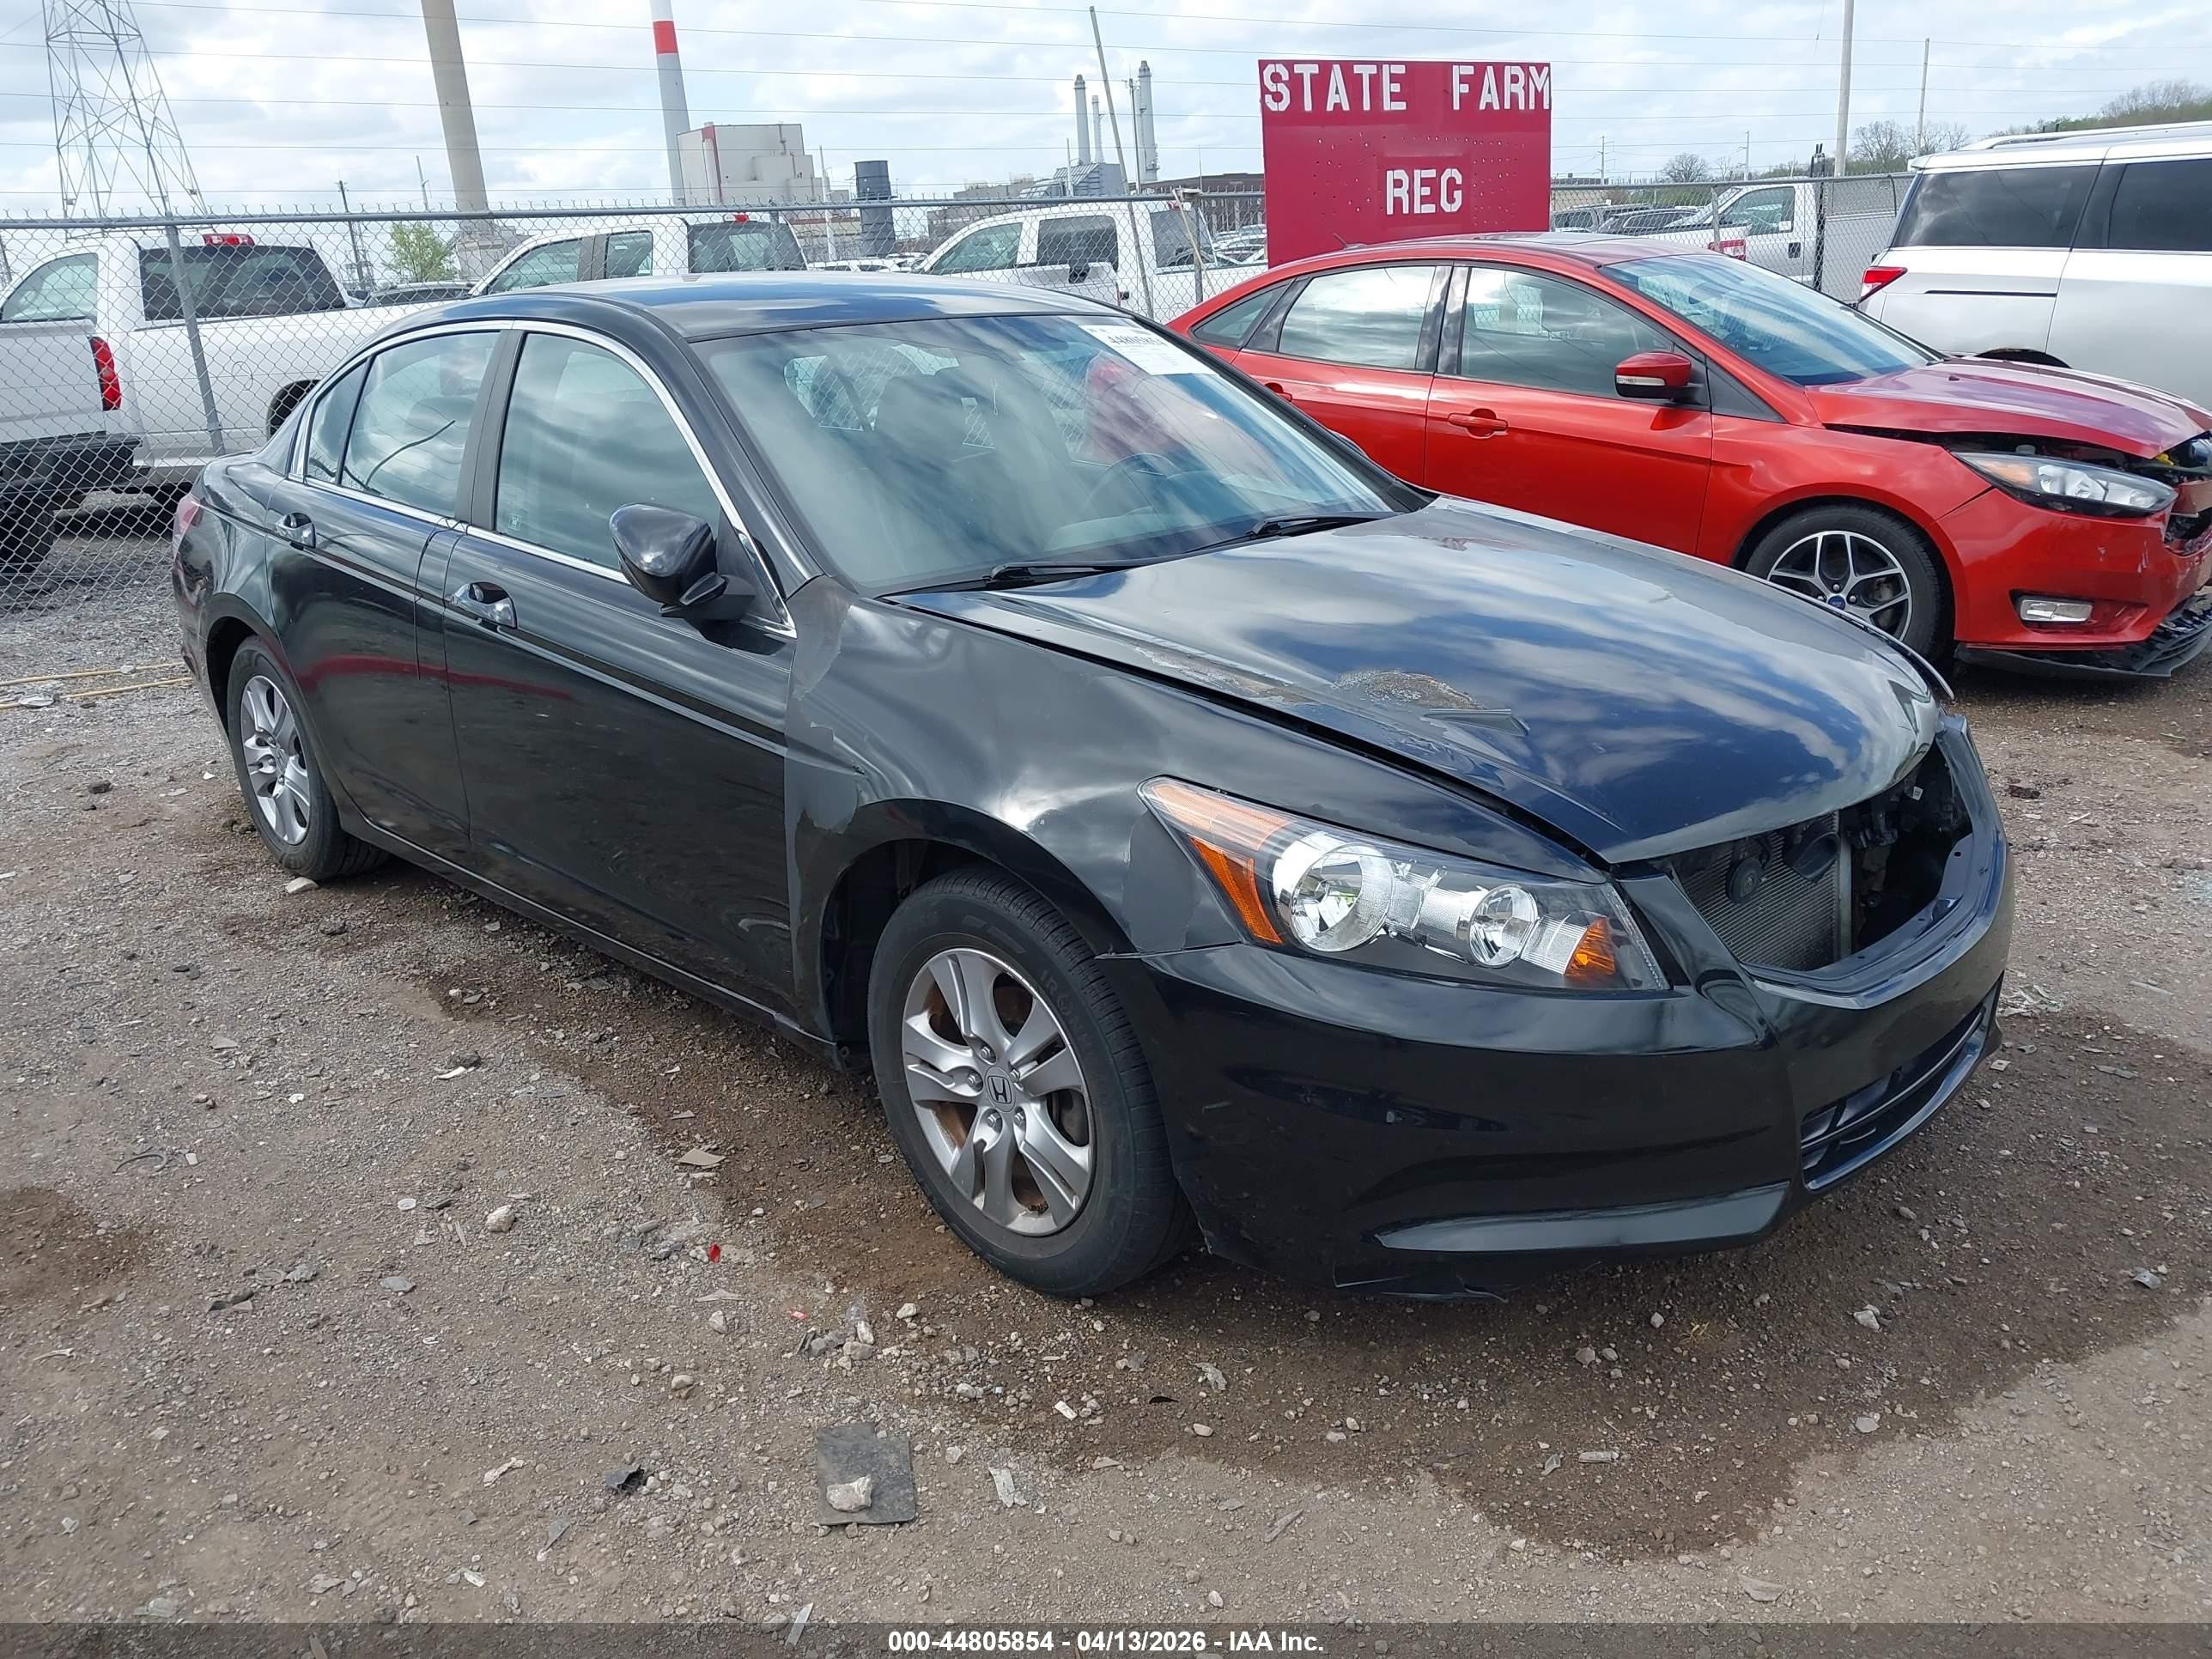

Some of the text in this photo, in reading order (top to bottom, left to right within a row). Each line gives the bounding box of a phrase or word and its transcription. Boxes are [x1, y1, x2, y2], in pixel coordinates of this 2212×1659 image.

[1262, 64, 1551, 112] STATE FARM
[1385, 168, 1462, 215] REG
